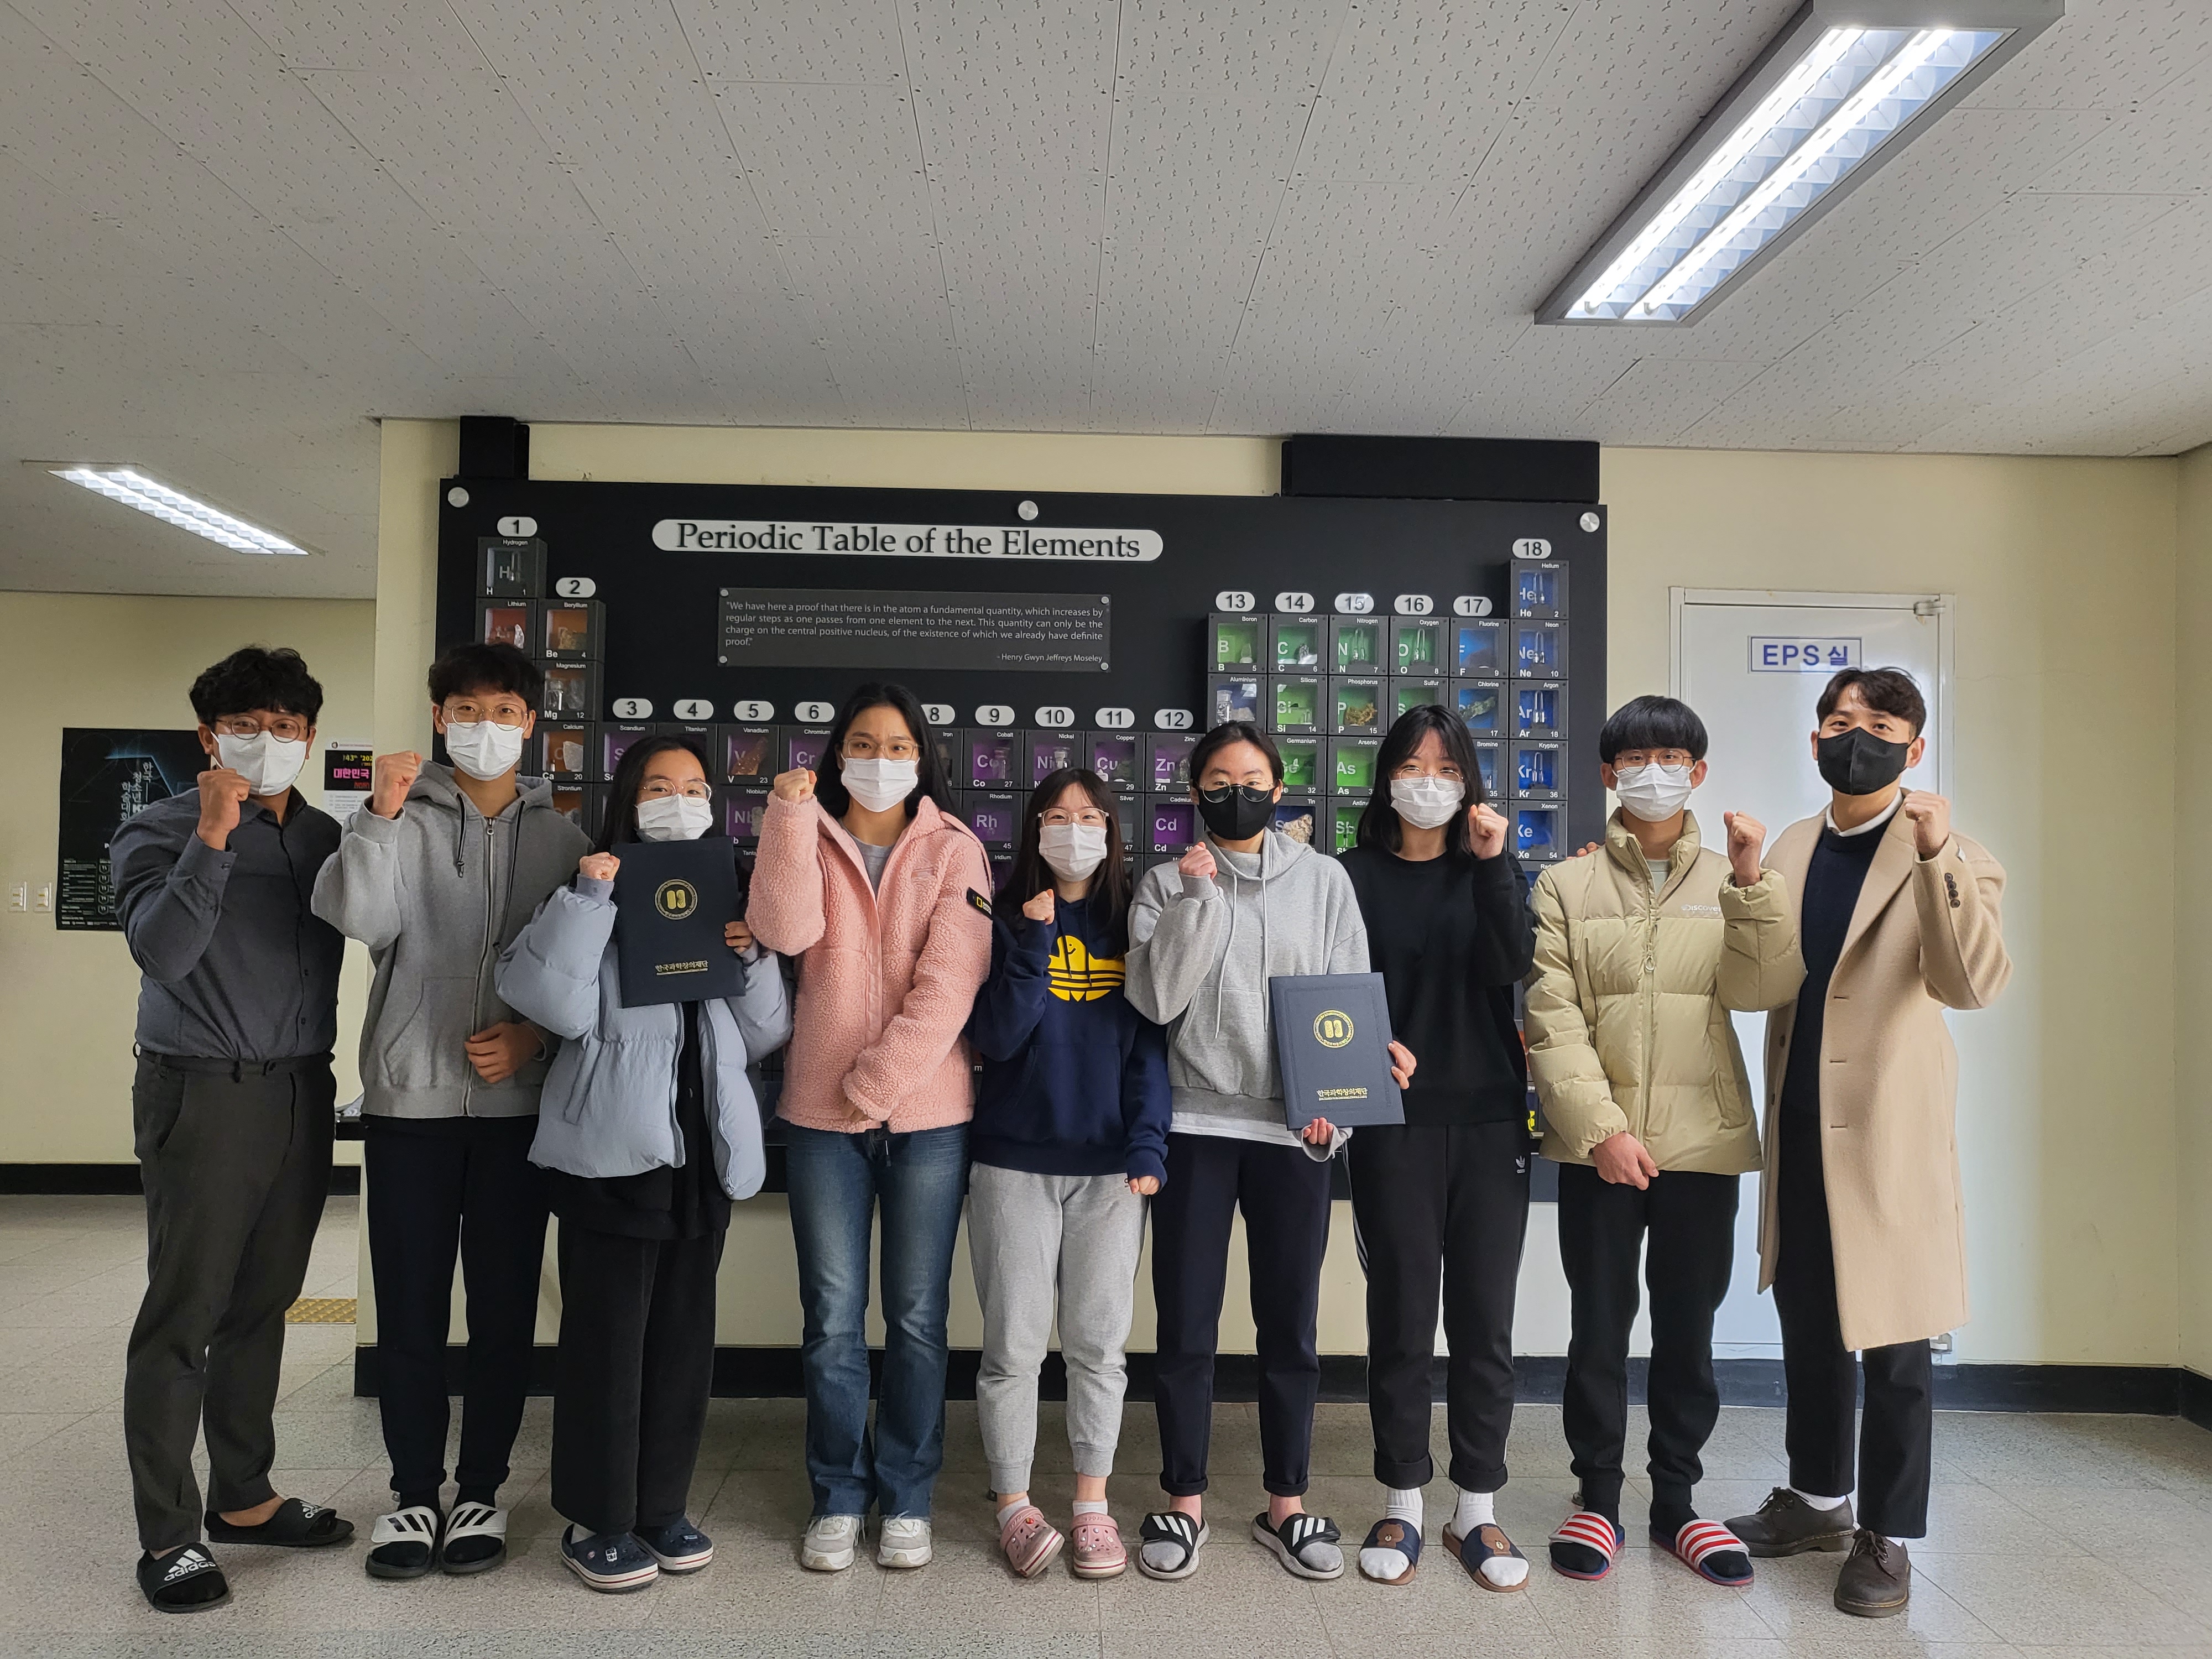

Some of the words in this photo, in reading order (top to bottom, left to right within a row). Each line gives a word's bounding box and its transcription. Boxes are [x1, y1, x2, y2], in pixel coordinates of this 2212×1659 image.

[513, 519, 519, 534] 1
[677, 523, 802, 550] Periodic
[813, 526, 896, 552] Table
[906, 528, 936, 552] of
[946, 529, 991, 554] the
[1002, 530, 1139, 557] Elements
[1522, 542, 1542, 555] 18
[570, 580, 580, 594] 2
[1225, 594, 1245, 609] 13
[1284, 595, 1305, 609] 14
[1345, 596, 1364, 611] 15
[1405, 597, 1424, 612] 16
[1464, 599, 1483, 613] 17
[745, 601, 765, 611] have
[768, 602, 786, 611] here
[796, 602, 820, 613] proof
[821, 603, 837, 612] that
[841, 603, 863, 612] there
[874, 604, 880, 613] in
[884, 604, 897, 613] the
[930, 604, 983, 614] fundamental
[987, 607, 1023, 617] quantity,
[1025, 606, 1050, 615] which
[1053, 607, 1091, 616] increases
[1093, 608, 1103, 618] by
[727, 613, 757, 624] regular
[759, 615, 781, 624] steps
[846, 615, 866, 624] from
[888, 616, 924, 625] element
[938, 617, 952, 626] the
[978, 618, 995, 626] This
[998, 618, 1033, 629] quantity
[1054, 619, 1072, 630] only
[1075, 619, 1086, 628] be
[1089, 619, 1103, 628] the
[726, 625, 754, 636] charge
[771, 626, 785, 634] the
[787, 626, 816, 635] central
[820, 628, 853, 638] positive
[855, 628, 889, 637] nucleus,
[893, 628, 901, 637] of
[904, 629, 917, 637] the
[919, 629, 959, 638] existence
[961, 629, 971, 638] of
[972, 630, 998, 638] which
[1015, 630, 1045, 641] already
[1048, 631, 1068, 640] have
[1071, 631, 1103, 640] definite
[1002, 653, 1023, 662] Henry
[1024, 654, 1044, 662] Gwyn
[1045, 654, 1072, 663] Jeffreys
[1074, 654, 1103, 664] Moseley
[1764, 645, 1820, 665] EPS
[1828, 645, 1848, 666] 실
[544, 711, 557, 719] Mg
[627, 702, 637, 715] 3
[687, 703, 698, 717] 4
[749, 704, 758, 718] 5
[810, 705, 819, 719] 6
[930, 707, 940, 721] 8
[990, 708, 1000, 722] 9
[1045, 709, 1065, 724] 10
[1107, 711, 1122, 725] 11
[1165, 712, 1184, 727] 12
[333, 768, 369, 779] 대한민국
[1316, 1087, 1368, 1097] 한국과학창의재단
[164, 1561, 216, 1581] adidas
